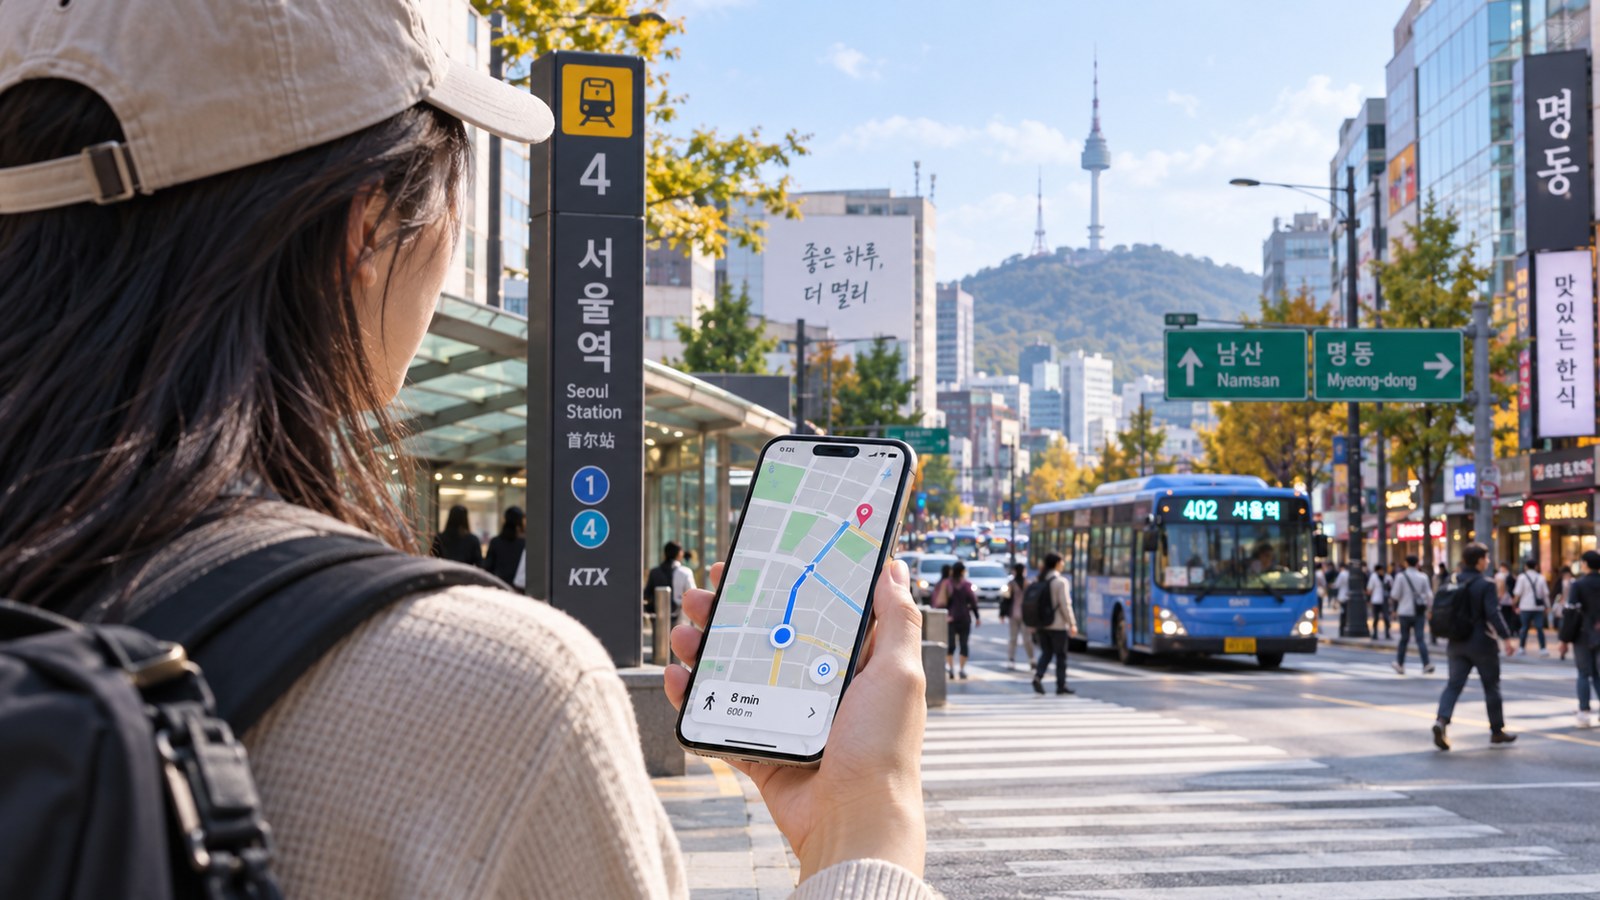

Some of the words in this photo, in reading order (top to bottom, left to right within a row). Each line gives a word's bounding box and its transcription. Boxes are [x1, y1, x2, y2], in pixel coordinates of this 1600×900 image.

[1537, 88, 1580, 197] 명동
[579, 152, 611, 195] 4
[802, 242, 836, 274] 좋은
[843, 242, 884, 272] 하루,
[577, 238, 614, 373] 서울역
[804, 282, 822, 305] 더
[831, 279, 868, 310] 멀리
[1555, 273, 1577, 350] 맛있는
[1217, 341, 1263, 366] 남산
[1327, 341, 1374, 367] 명동
[566, 383, 609, 399] Seoul
[1217, 372, 1280, 388] Namsan
[1327, 372, 1417, 391] Myeong-dong
[1556, 358, 1577, 409] 한식
[566, 403, 622, 420] Station
[566, 431, 615, 449] 首尔站
[585, 475, 595, 496] 1
[1183, 499, 1218, 521] 402
[1231, 500, 1280, 521] 서울역
[582, 518, 598, 540] 4
[568, 567, 610, 586] KTX
[730, 692, 739, 703] 8
[740, 694, 760, 706] min
[726, 707, 744, 717] 600
[744, 710, 753, 718] m
